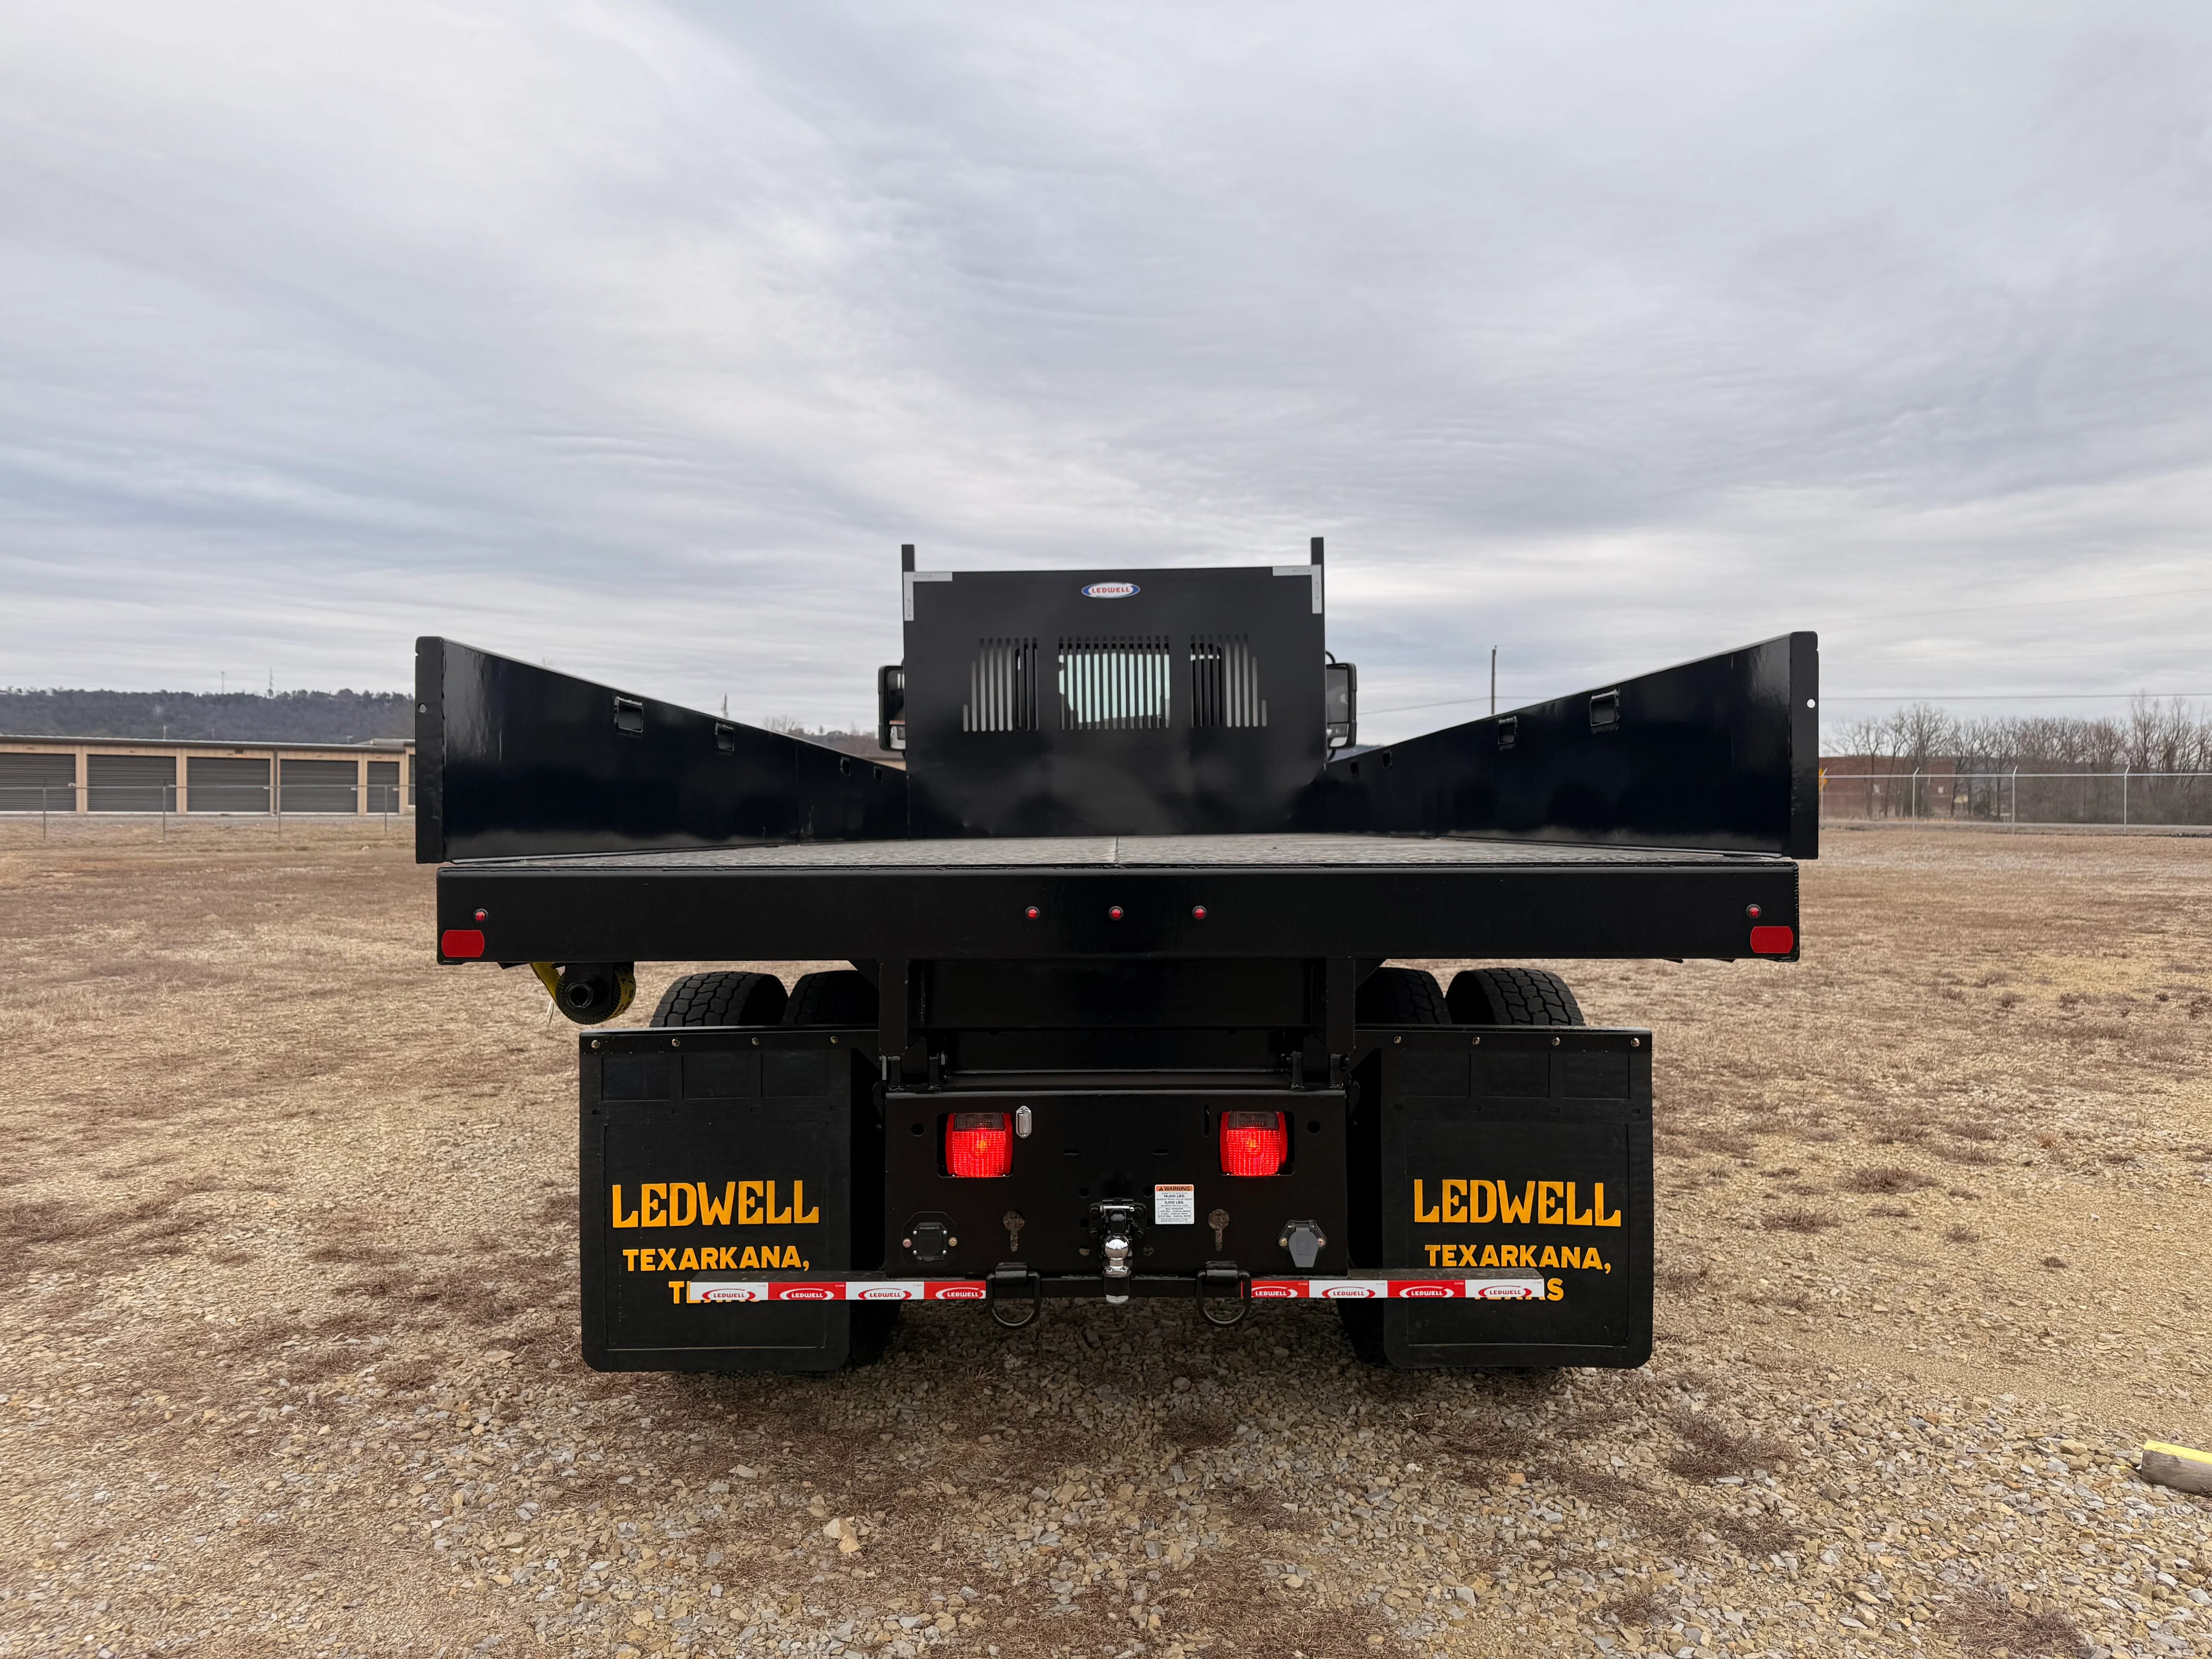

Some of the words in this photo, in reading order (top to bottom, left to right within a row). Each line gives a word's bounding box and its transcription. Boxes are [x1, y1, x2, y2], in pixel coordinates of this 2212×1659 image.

[613, 1181, 819, 1228] LEDWELL
[1414, 1180, 1621, 1227] LEDWELL
[623, 1247, 809, 1271] TEXARKANA,
[1425, 1245, 1611, 1274] TEXARKANA,
